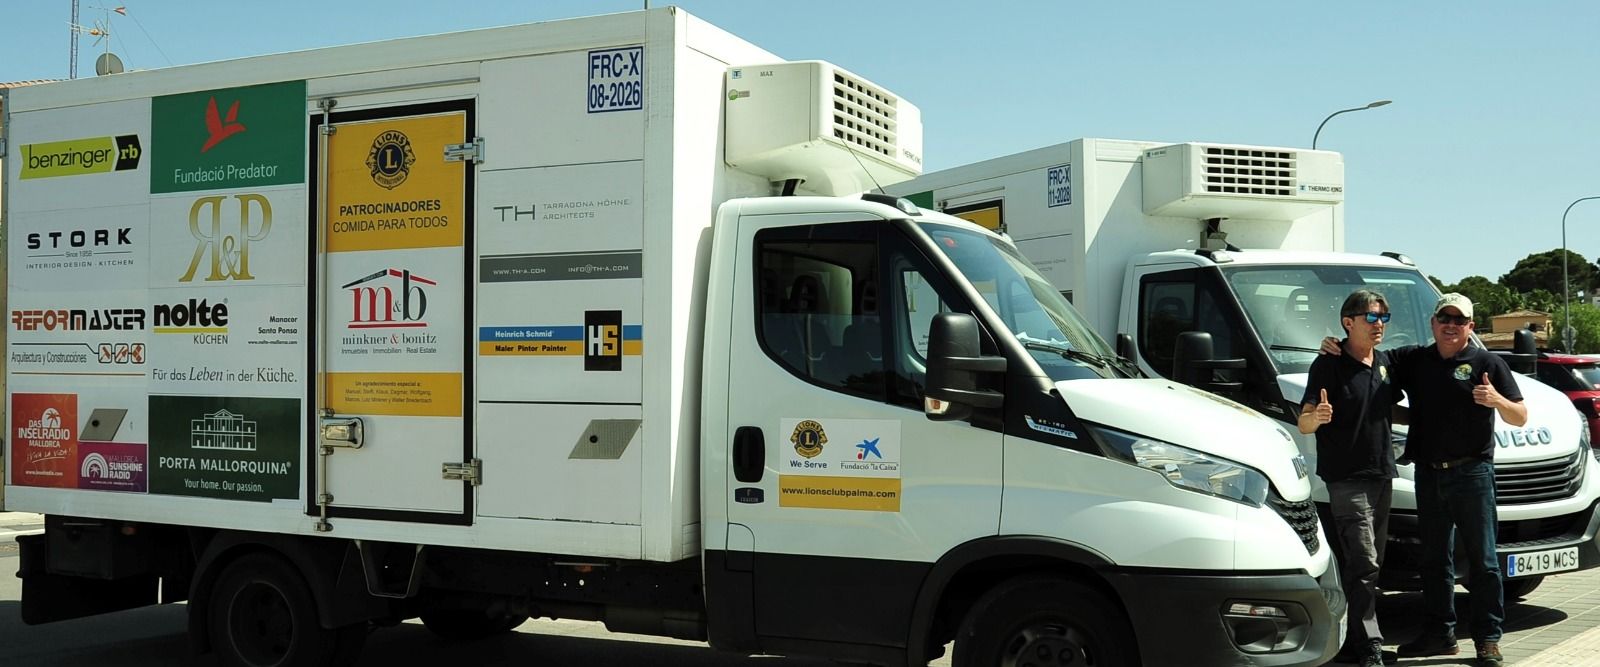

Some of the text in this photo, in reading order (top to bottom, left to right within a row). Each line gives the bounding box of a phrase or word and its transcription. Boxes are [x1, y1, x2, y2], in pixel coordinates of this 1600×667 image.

[590, 51, 640, 79] FRC-X
[589, 80, 641, 109] 08-2026
[377, 132, 407, 147] LIONS
[28, 144, 111, 169] benzinger
[120, 144, 138, 160] rb
[385, 149, 397, 169] L
[174, 164, 278, 184] Fundació Predator
[1049, 168, 1070, 186] FRC-X
[339, 200, 441, 216] PATROCINADORES
[493, 204, 536, 222] TH
[543, 211, 595, 220] ARCHITECTS
[333, 216, 448, 233] COMIDA PARA TODOS
[27, 228, 132, 249] STORK
[11, 309, 146, 331] REFORMASTER
[153, 298, 228, 327] nolte
[193, 334, 228, 345] KÜCHEN
[342, 333, 437, 345] minkner & bonitz
[588, 325, 618, 357] HS
[152, 366, 298, 383] Für das Leben in der Küche.
[28, 419, 42, 428] DAS
[798, 421, 820, 432] LIONS
[18, 428, 70, 440] INSELRADIO
[805, 432, 814, 445] L
[1494, 427, 1552, 448] VECO
[28, 440, 61, 448] MALLORCA
[109, 462, 143, 471] SUNSHINE
[159, 456, 196, 470] PORTA
[790, 460, 827, 469] We Serve
[109, 471, 131, 479] RADIO
[184, 478, 264, 492] Your home. Our passion.
[782, 487, 896, 498] www.lionsclubpalma.com
[1517, 551, 1577, 573] 8419 MCS
